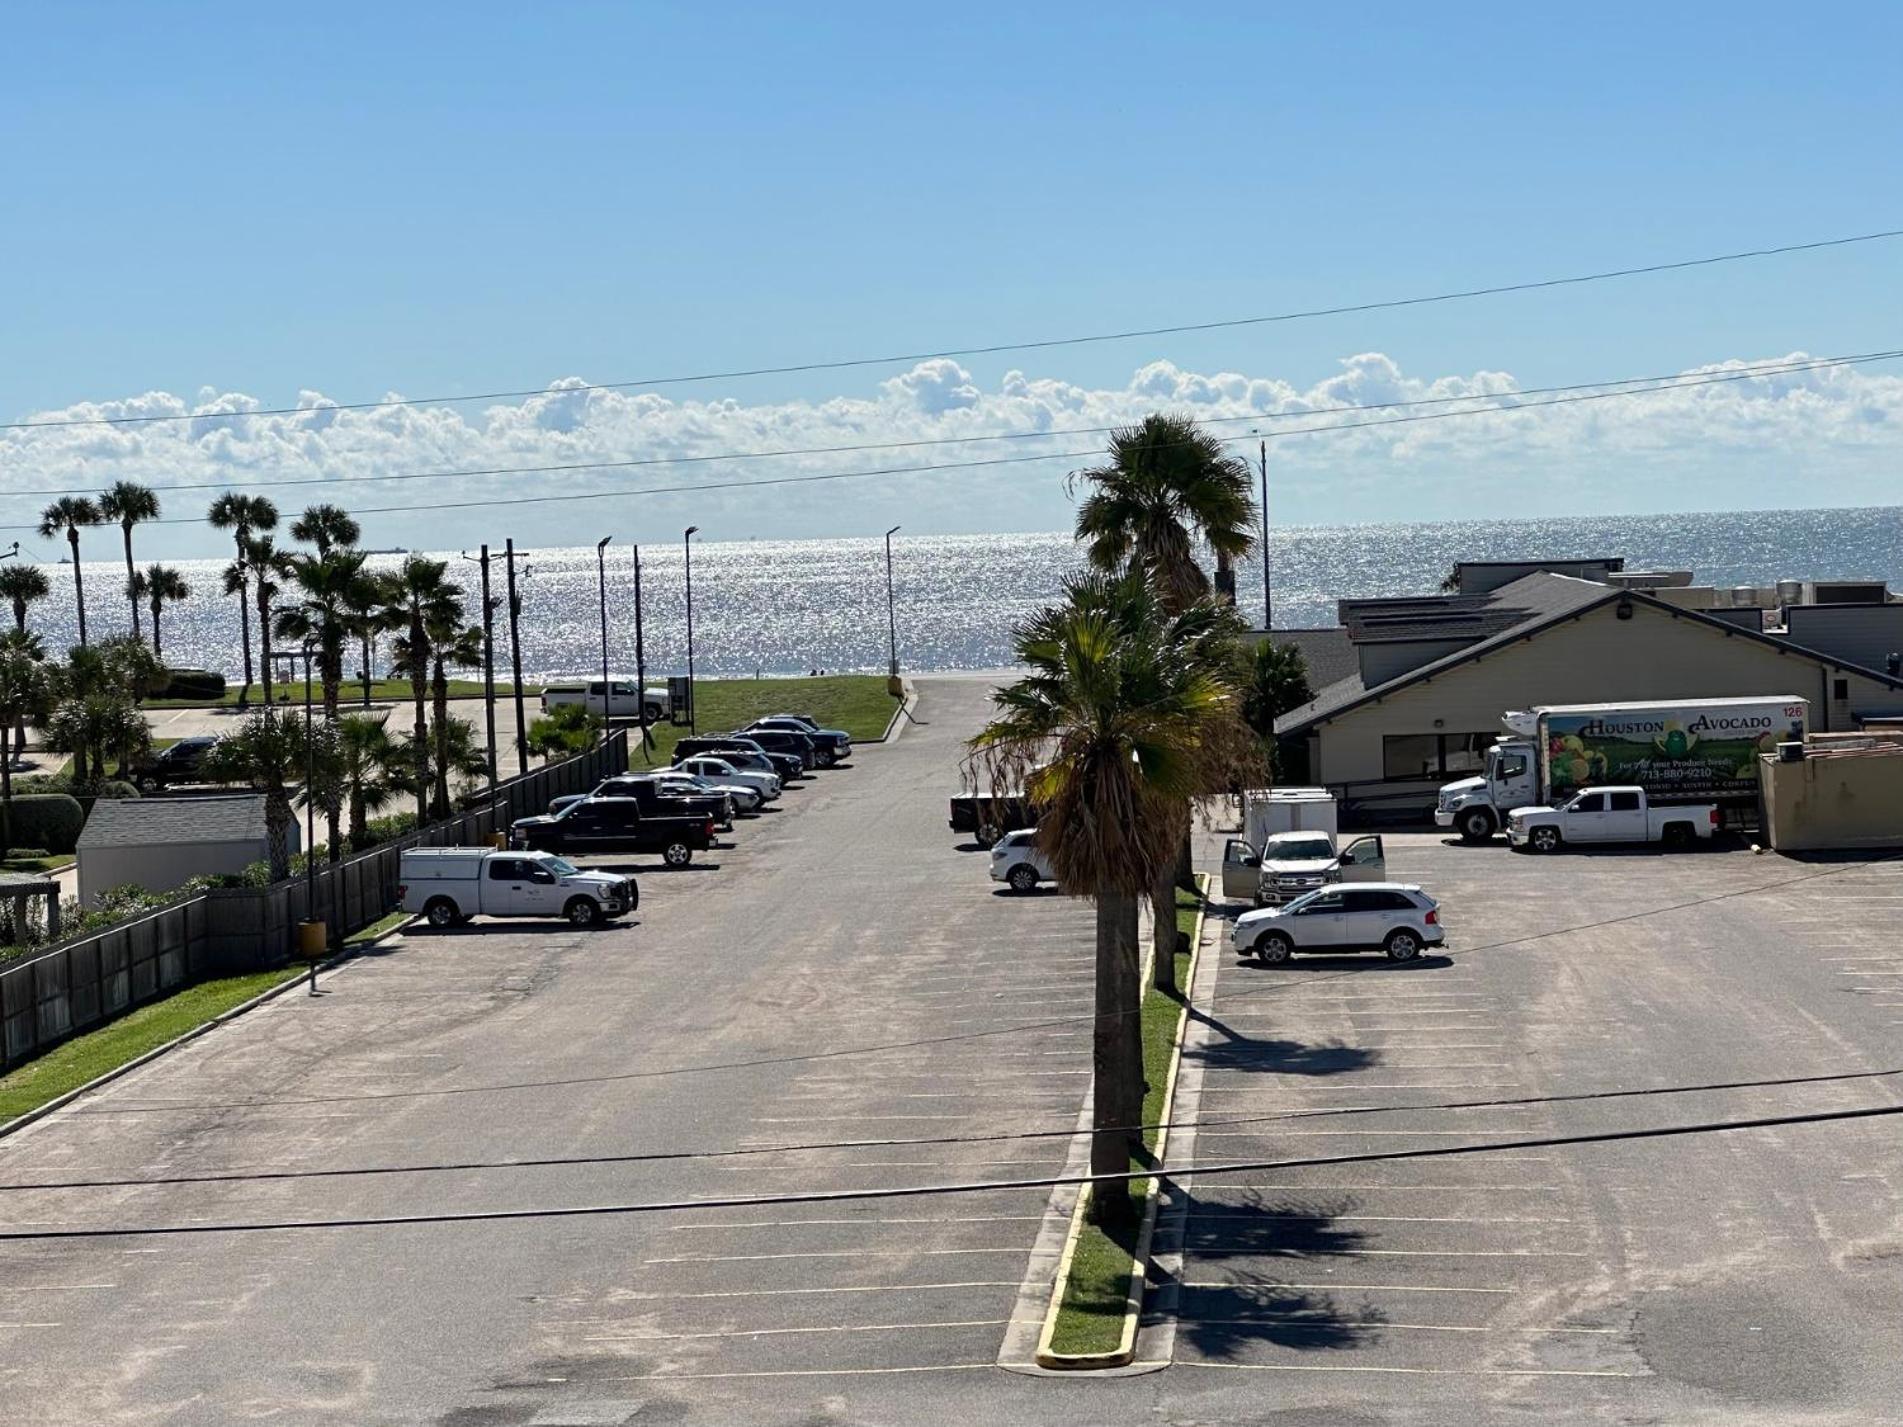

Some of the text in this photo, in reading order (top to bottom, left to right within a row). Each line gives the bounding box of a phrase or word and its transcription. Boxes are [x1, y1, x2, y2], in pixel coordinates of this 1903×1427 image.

[1784, 706, 1803, 718] 126
[1672, 758, 1706, 768] Produce
[1641, 767, 1712, 780] 713-880-9210
